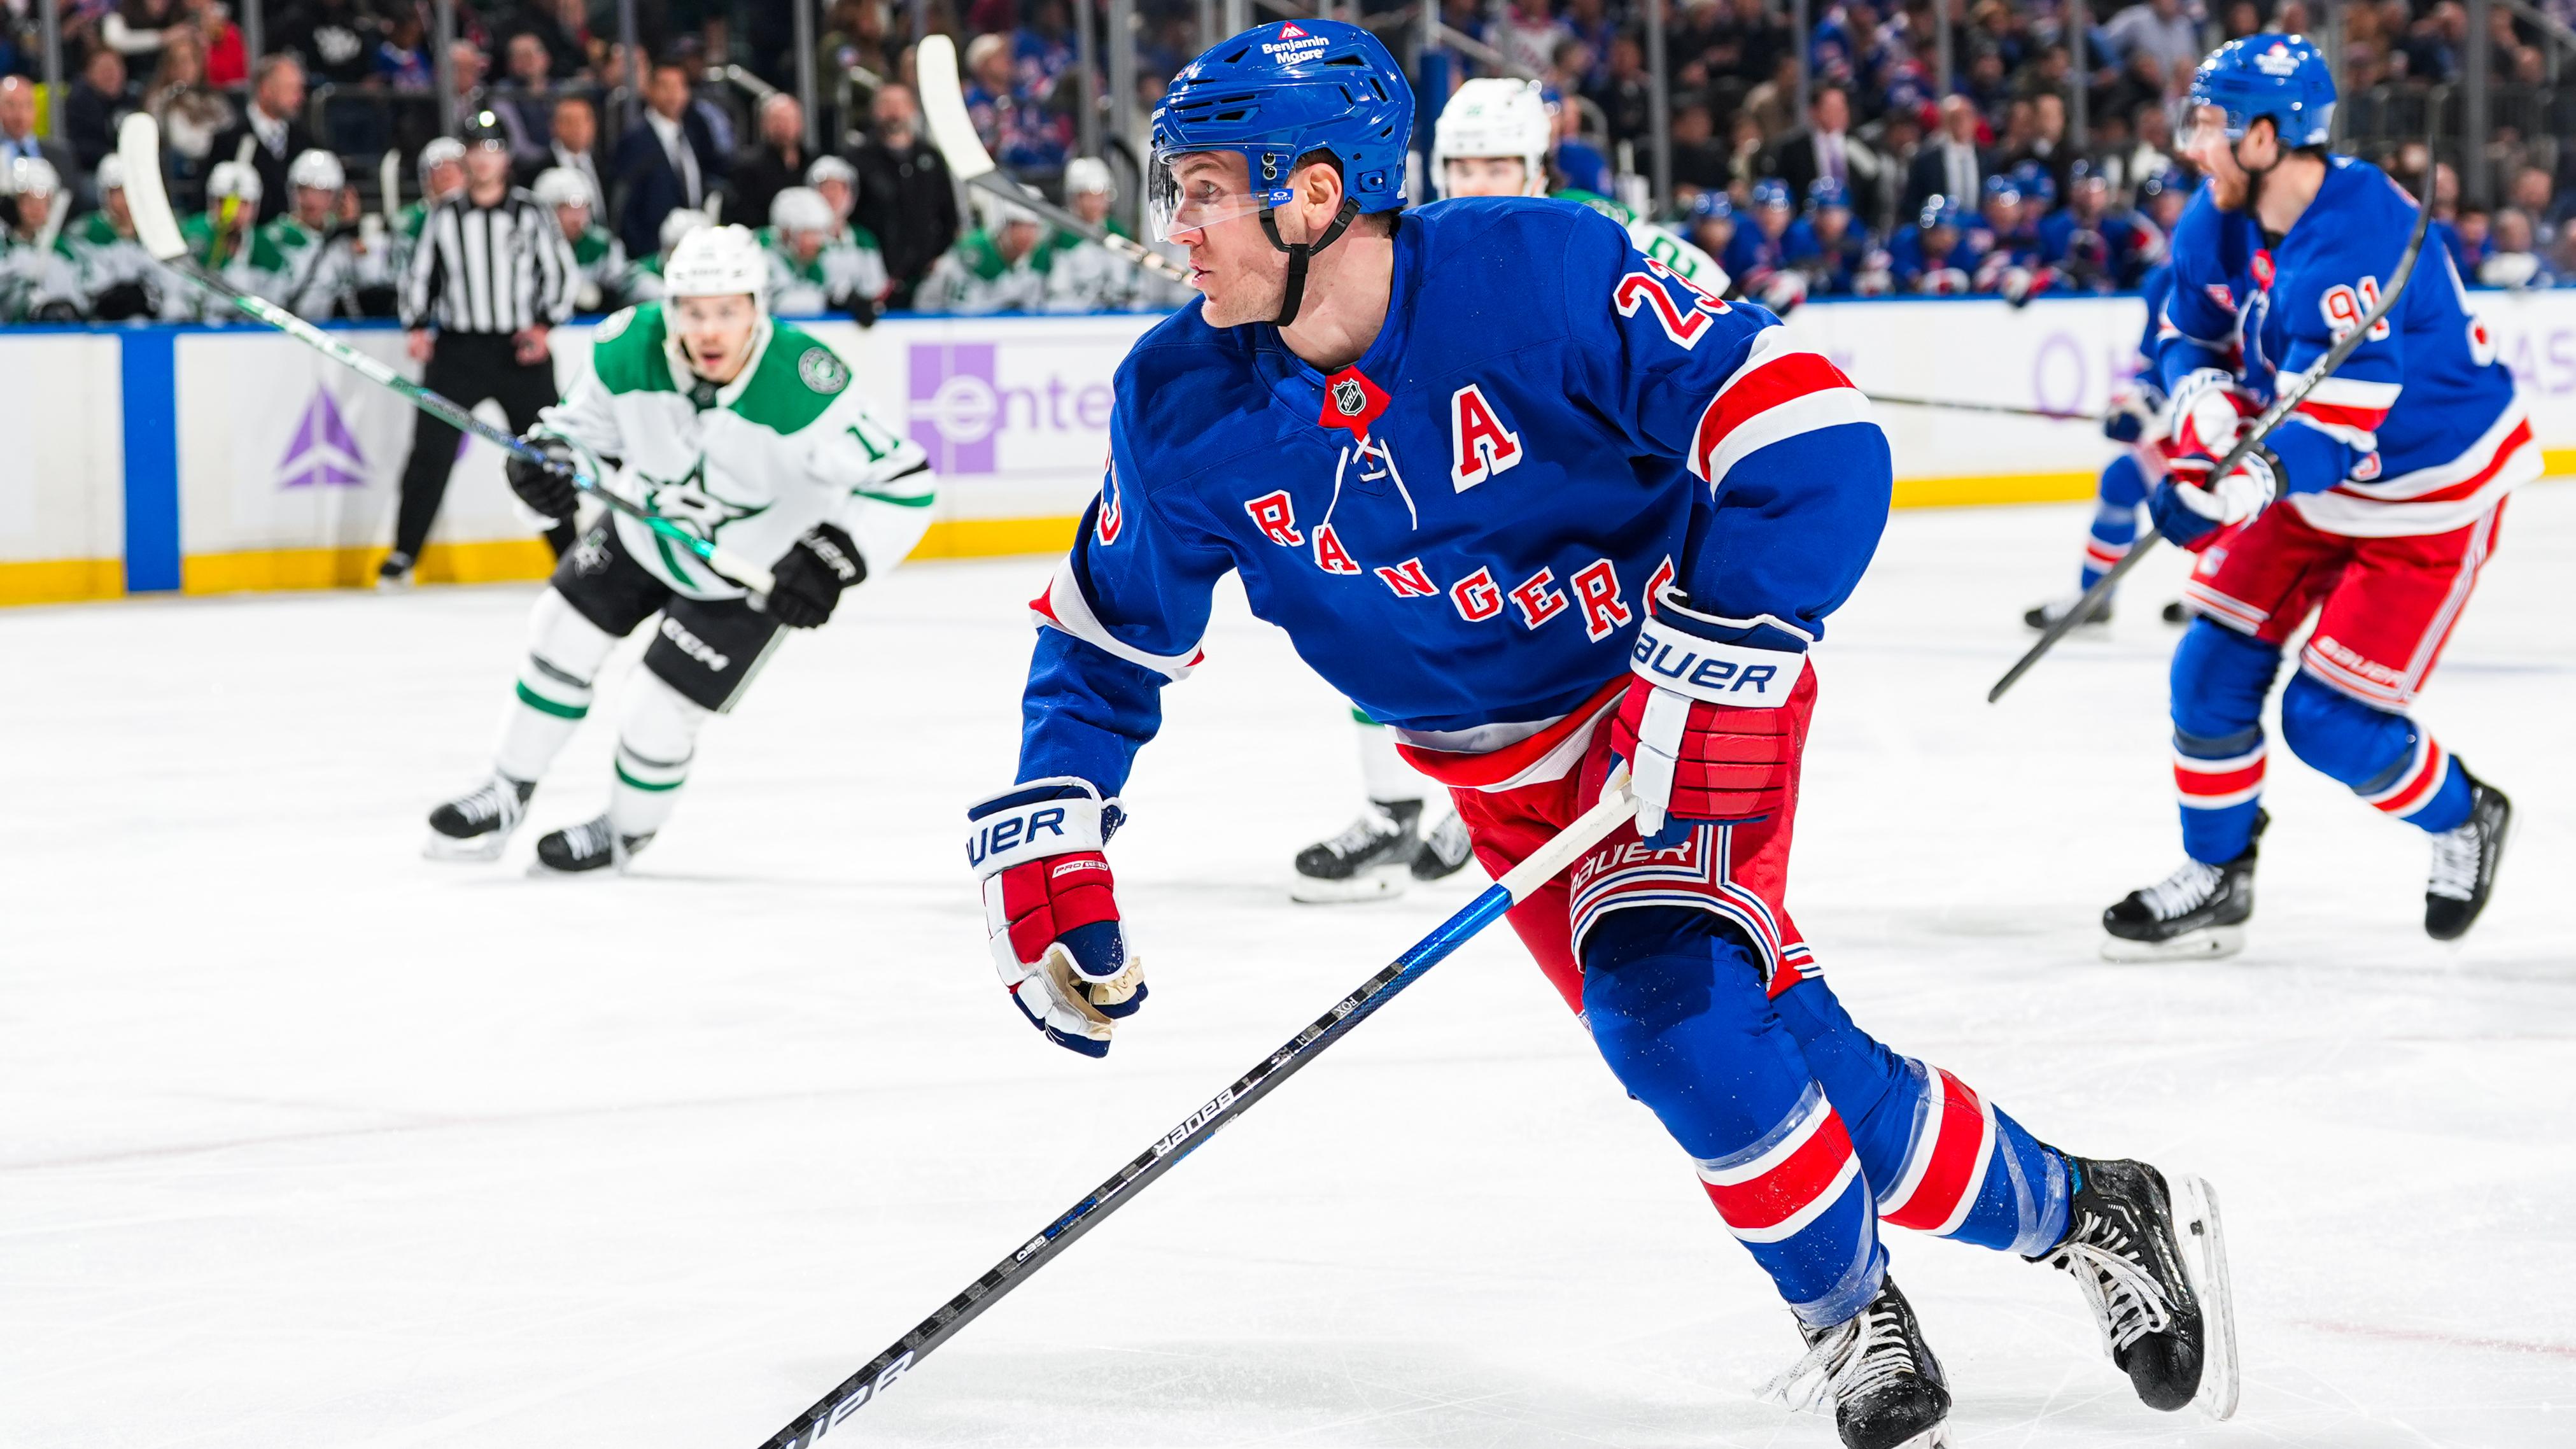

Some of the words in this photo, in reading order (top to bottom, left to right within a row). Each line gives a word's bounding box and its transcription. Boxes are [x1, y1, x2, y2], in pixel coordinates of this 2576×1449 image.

[1262, 36, 1330, 54] Benjamin
[1275, 48, 1323, 64] Moore
[1613, 257, 1733, 351] 23
[1343, 388, 1357, 410] NHL
[1451, 383, 1523, 494] A
[1334, 996, 1358, 1016] FOX
[1017, 1235, 1046, 1261] GEO
